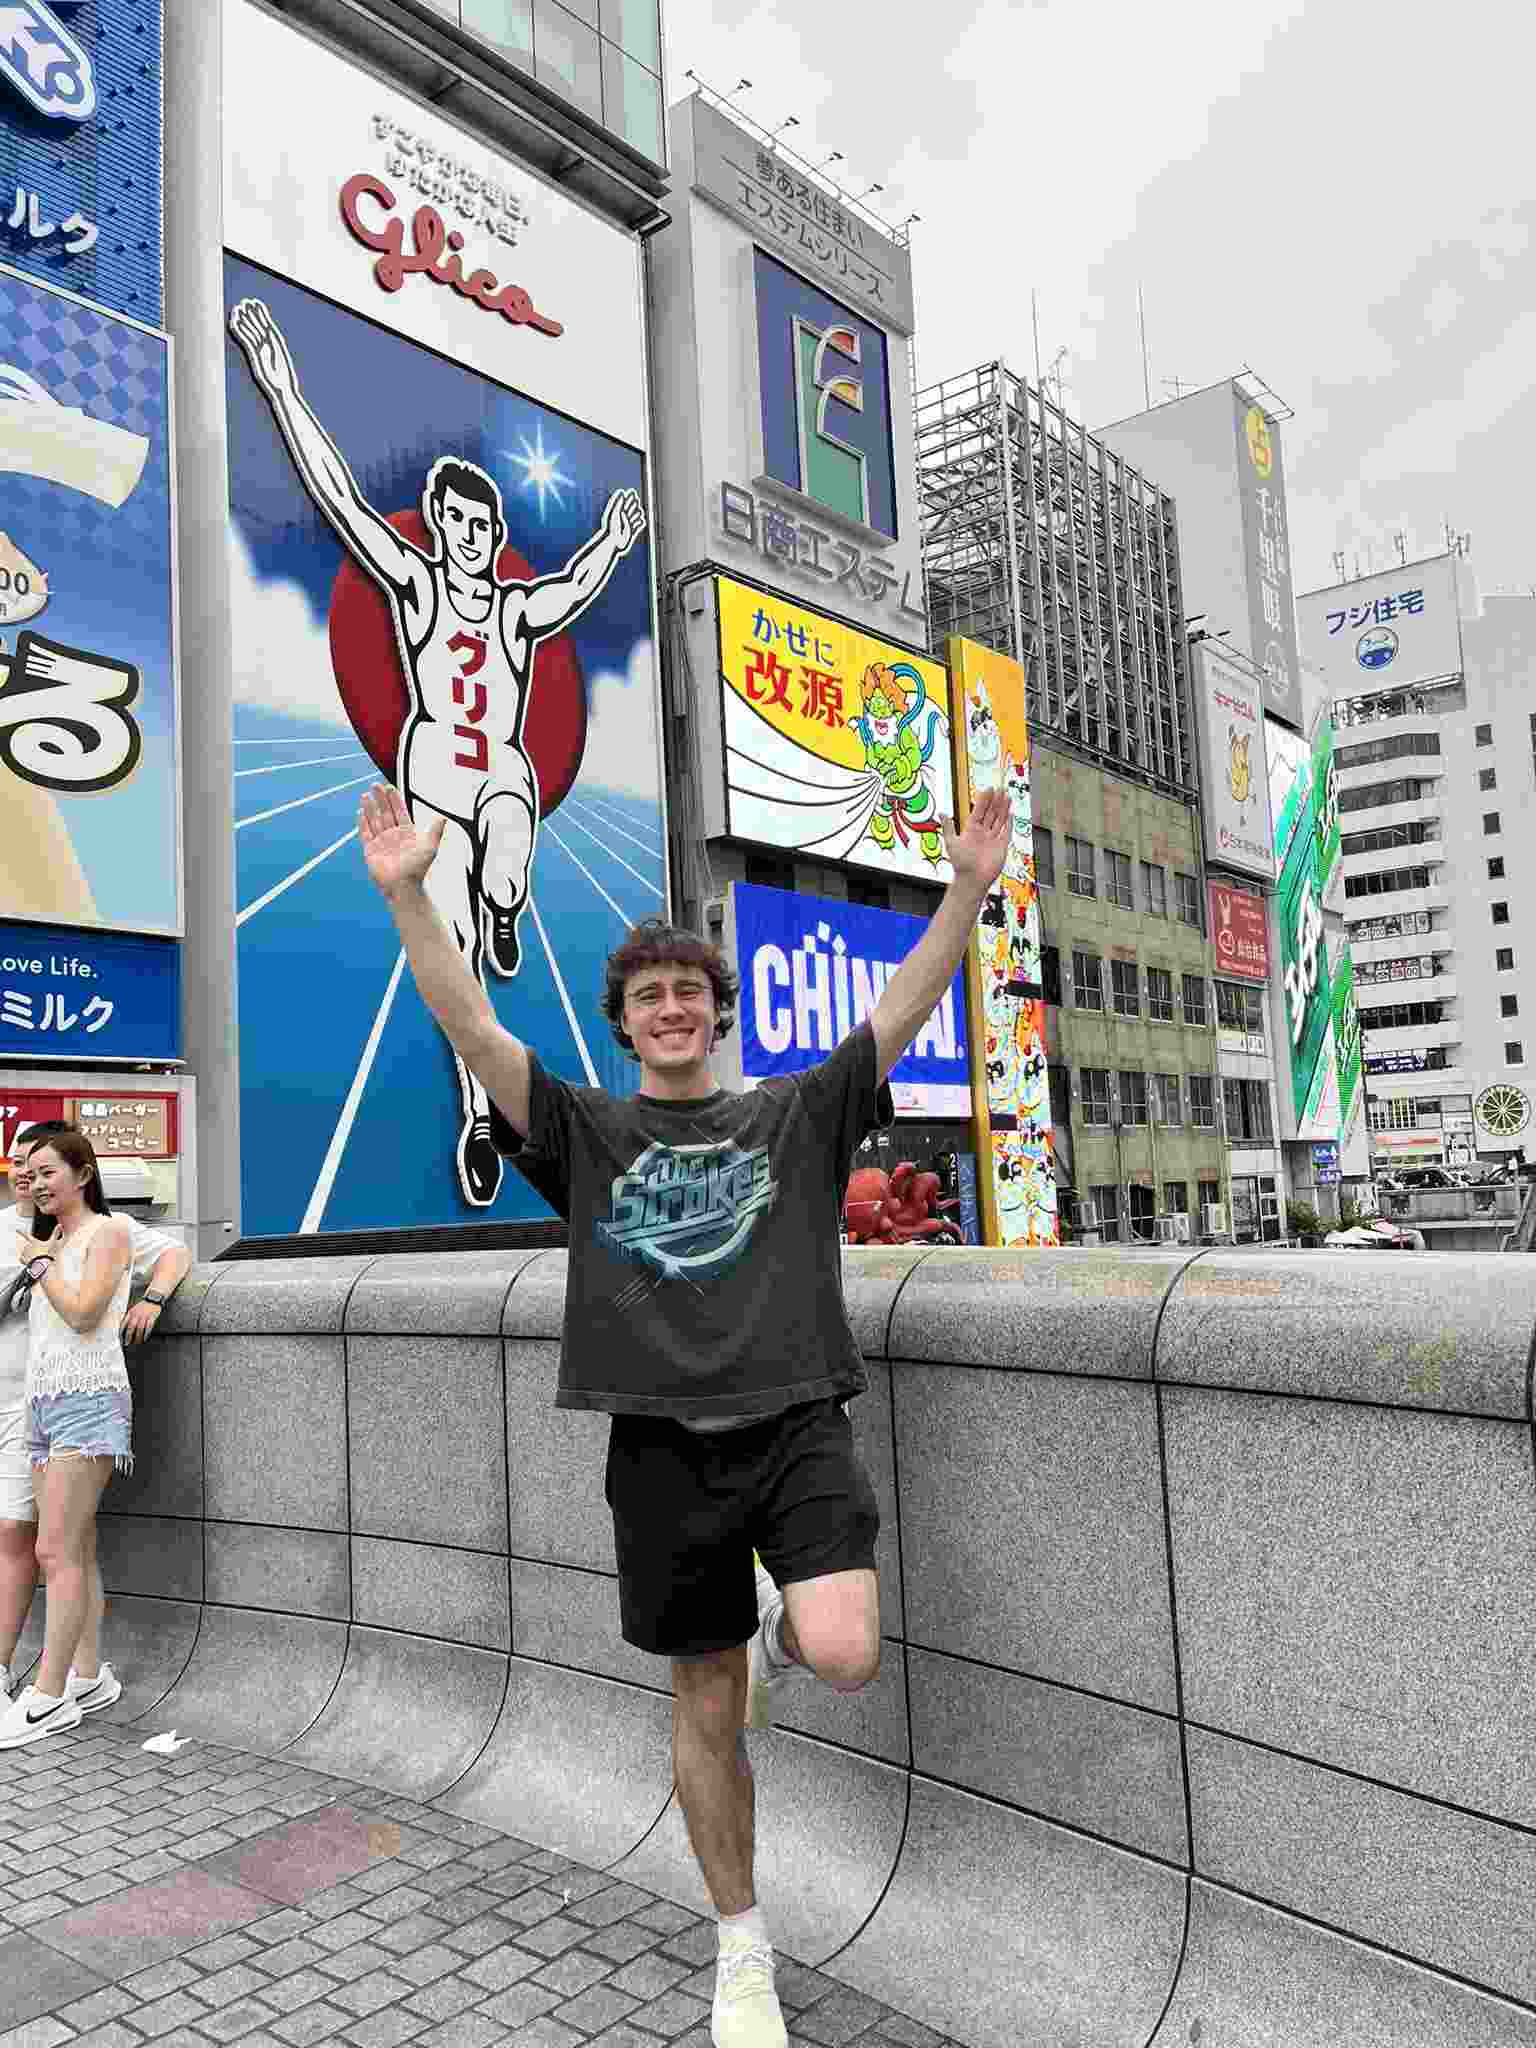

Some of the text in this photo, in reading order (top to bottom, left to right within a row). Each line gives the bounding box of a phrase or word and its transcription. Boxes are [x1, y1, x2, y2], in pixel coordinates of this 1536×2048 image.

[0, 186, 98, 253] ルク
[339, 173, 565, 339] Glico
[751, 607, 834, 668] かぜに
[1325, 588, 1425, 635] フジ住宅
[446, 630, 490, 772] グリコ
[742, 645, 845, 728] 改源
[0, 956, 98, 979] ove Life.
[1, 990, 114, 1033] ミルク
